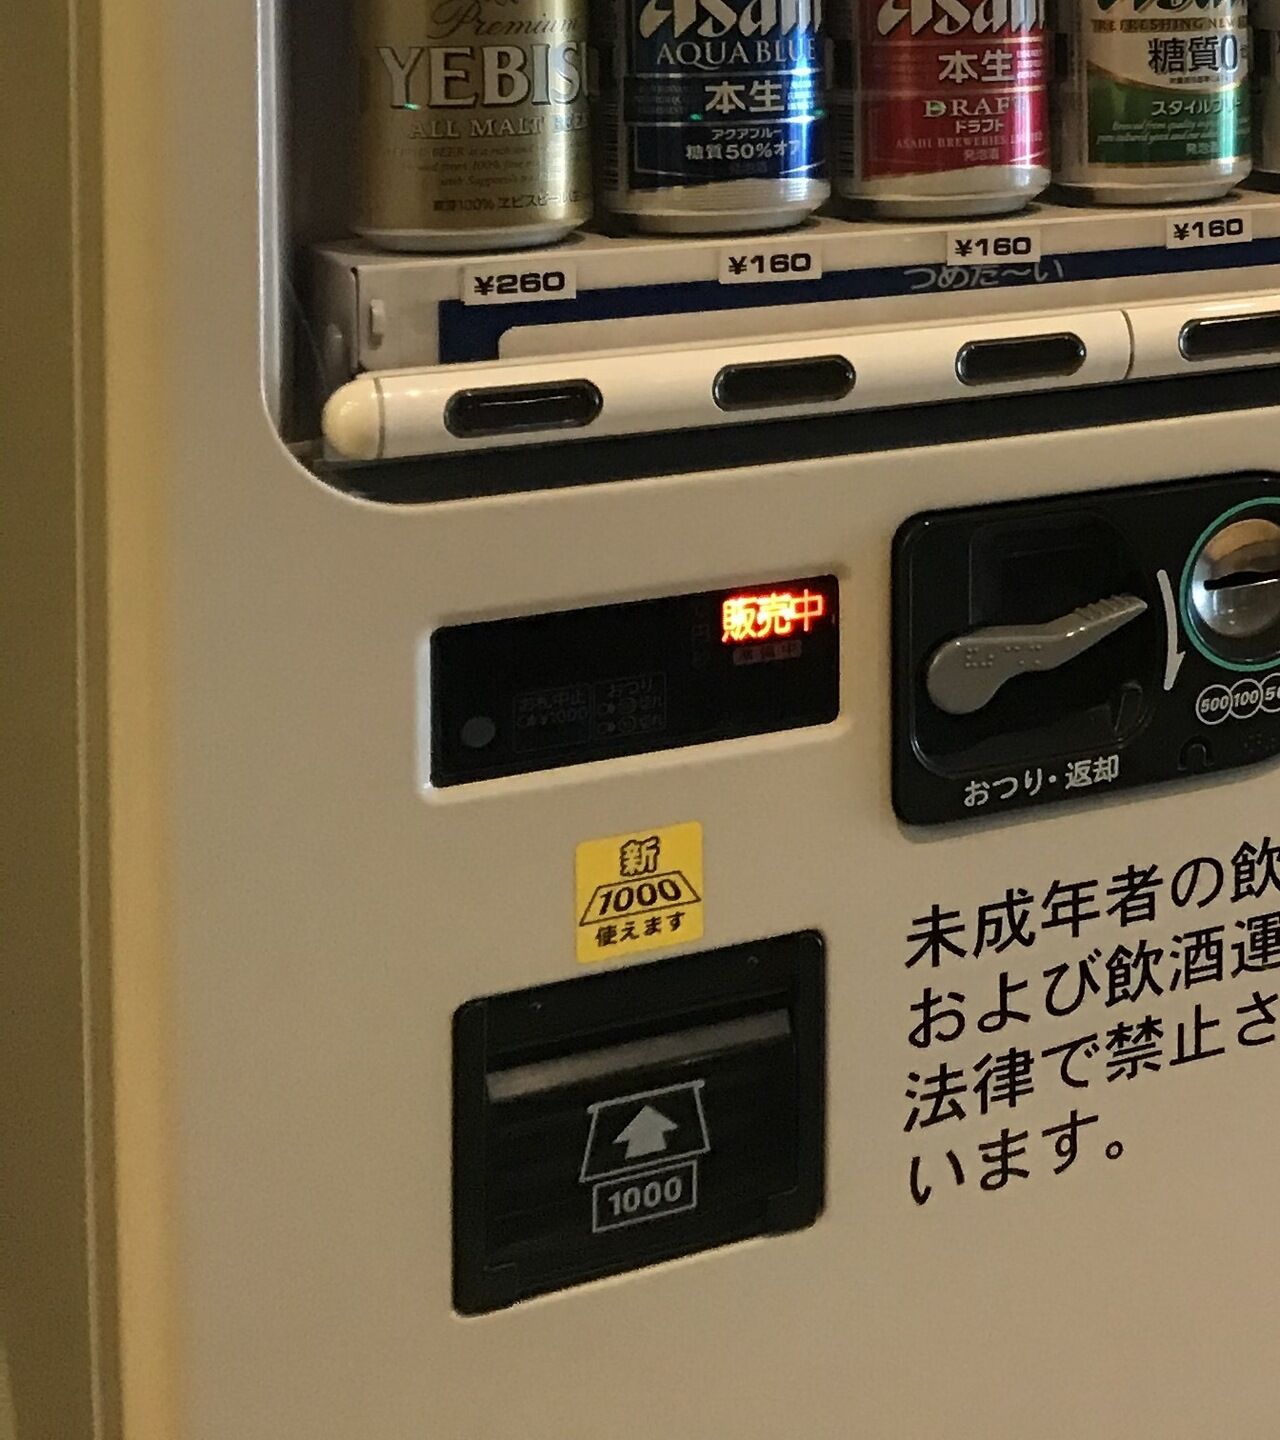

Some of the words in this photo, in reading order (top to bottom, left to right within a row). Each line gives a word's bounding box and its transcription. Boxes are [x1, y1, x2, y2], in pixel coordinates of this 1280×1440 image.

[656, 40, 750, 71] AQUA
[756, 38, 816, 64] BLUE
[938, 49, 1015, 84] 本生
[377, 40, 588, 110] YEBIS
[704, 79, 785, 114] 本生
[410, 118, 461, 139] ALL
[470, 116, 545, 137] MALT
[711, 127, 783, 141] アクアブルー
[955, 118, 1005, 134] ドラフト
[1173, 218, 1244, 240] ¥160
[729, 253, 812, 274] ¥160
[955, 236, 1032, 257] ¥160
[474, 271, 565, 295] ¥260
[722, 589, 823, 642] 販売中
[1200, 695, 1229, 712] 500
[1234, 690, 1259, 707] 100
[964, 755, 1119, 806] おつり・返却
[619, 835, 660, 874] 新
[598, 878, 682, 917] 1000
[594, 908, 686, 947] 使えます
[908, 1112, 1127, 1207] います。
[608, 1176, 682, 1217] 1000
